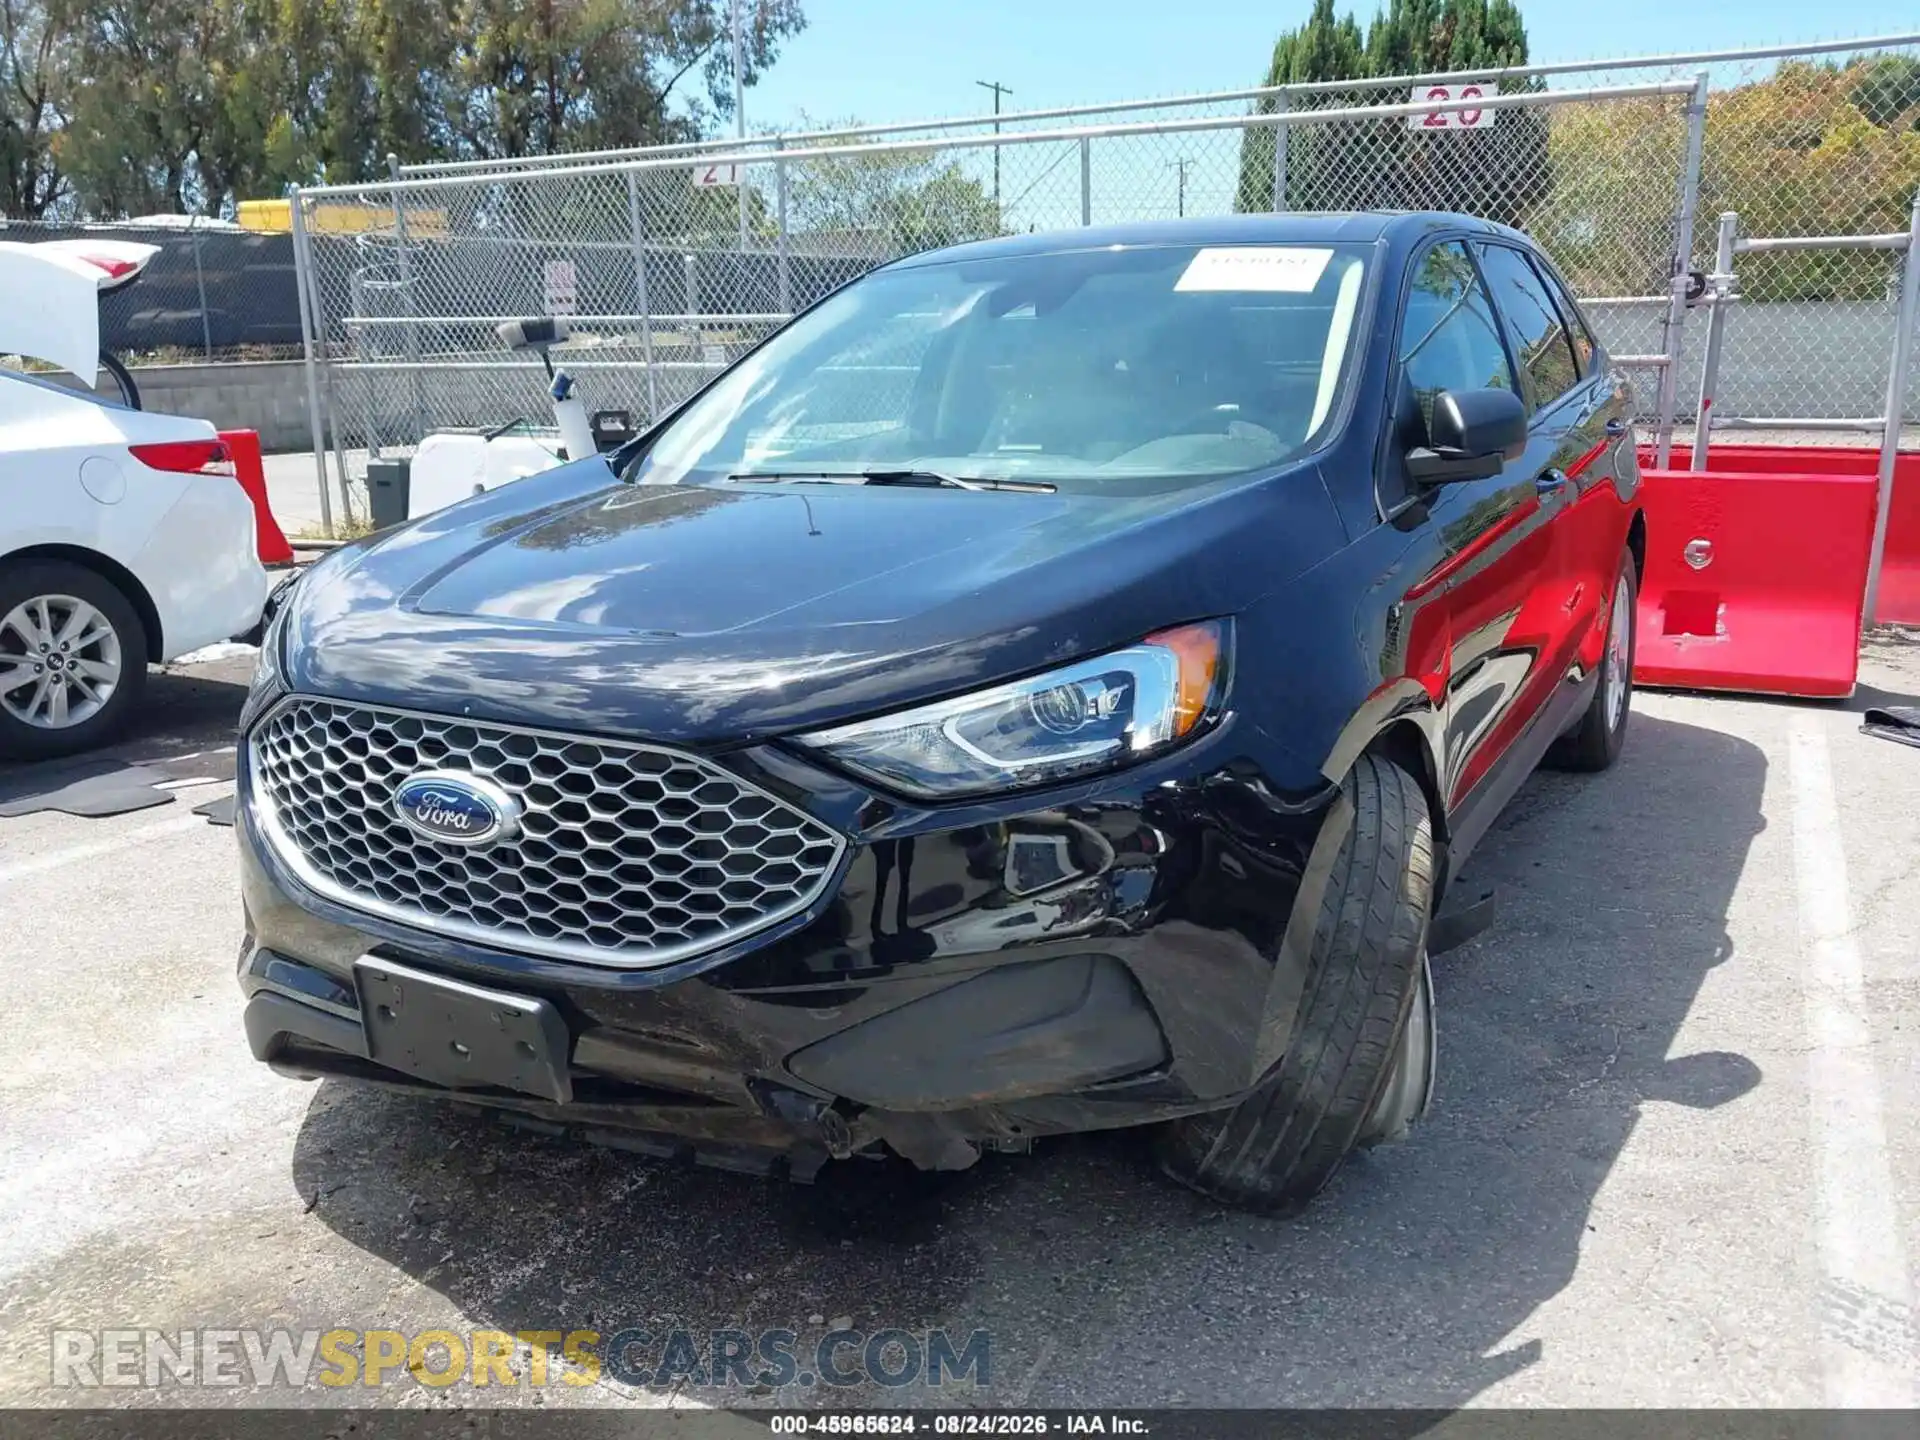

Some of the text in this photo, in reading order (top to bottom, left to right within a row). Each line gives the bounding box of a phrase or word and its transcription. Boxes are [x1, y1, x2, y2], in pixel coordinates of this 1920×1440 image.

[1423, 87, 1482, 126] 20
[702, 162, 737, 184] 21
[415, 791, 472, 830] Ford
